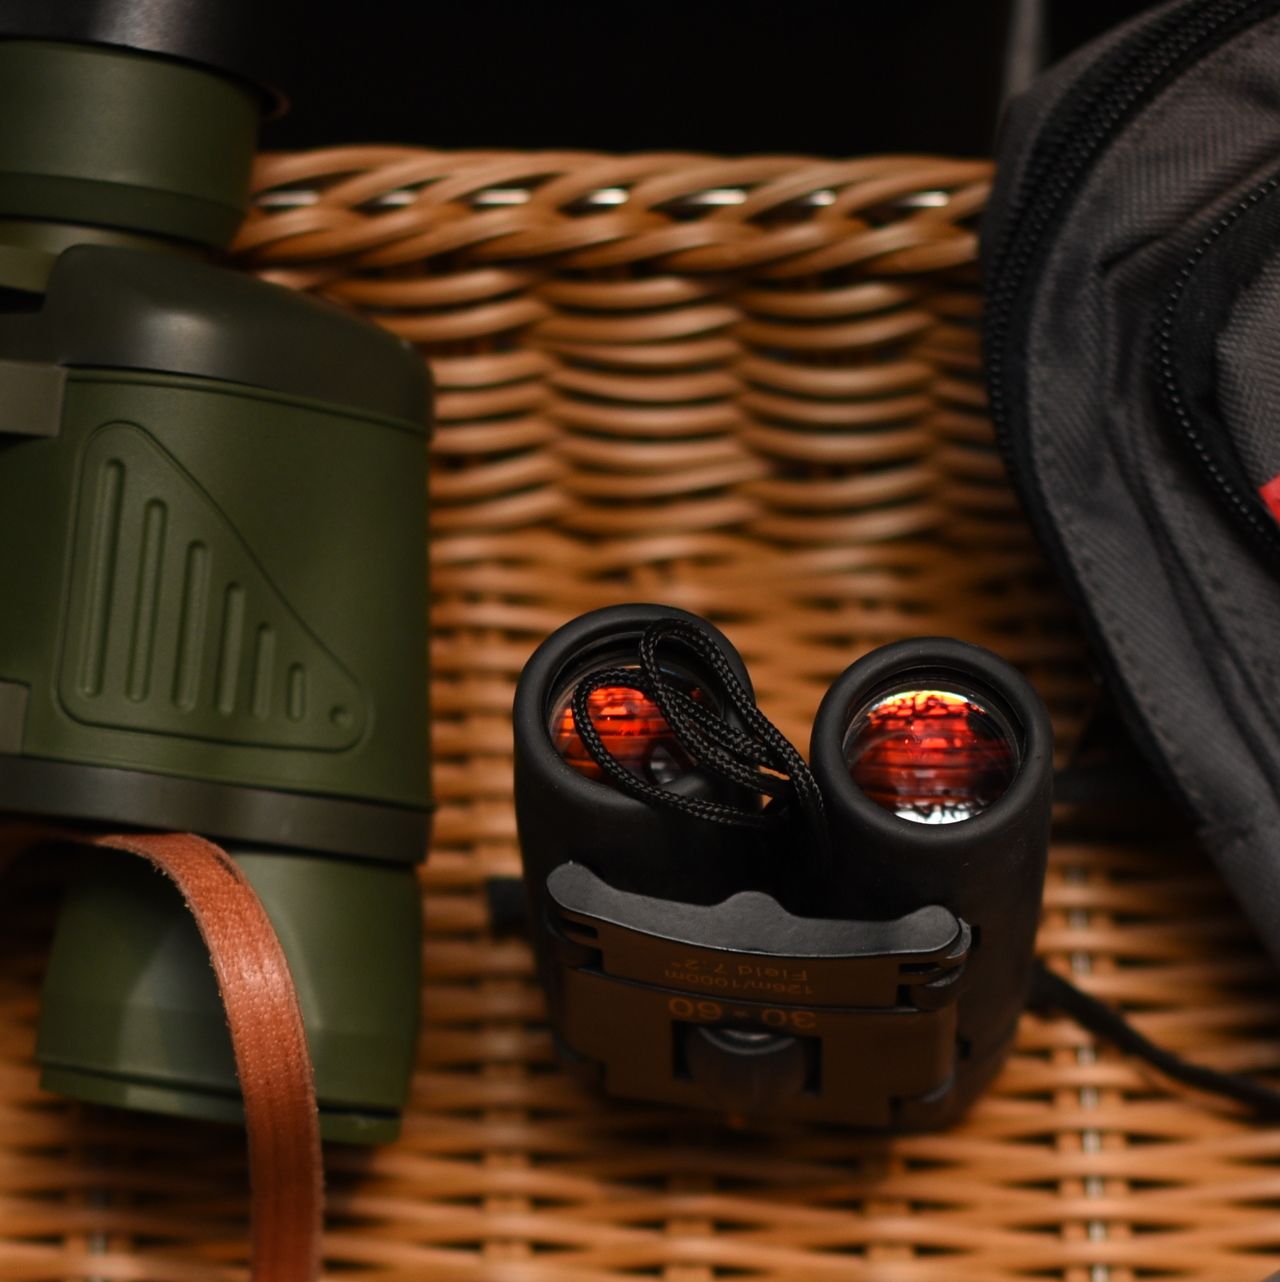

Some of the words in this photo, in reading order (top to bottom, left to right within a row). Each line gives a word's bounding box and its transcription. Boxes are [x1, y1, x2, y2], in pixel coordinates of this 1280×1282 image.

[737, 964, 808, 982] Field
[667, 997, 722, 1020] 60
[761, 1007, 817, 1030] 30
